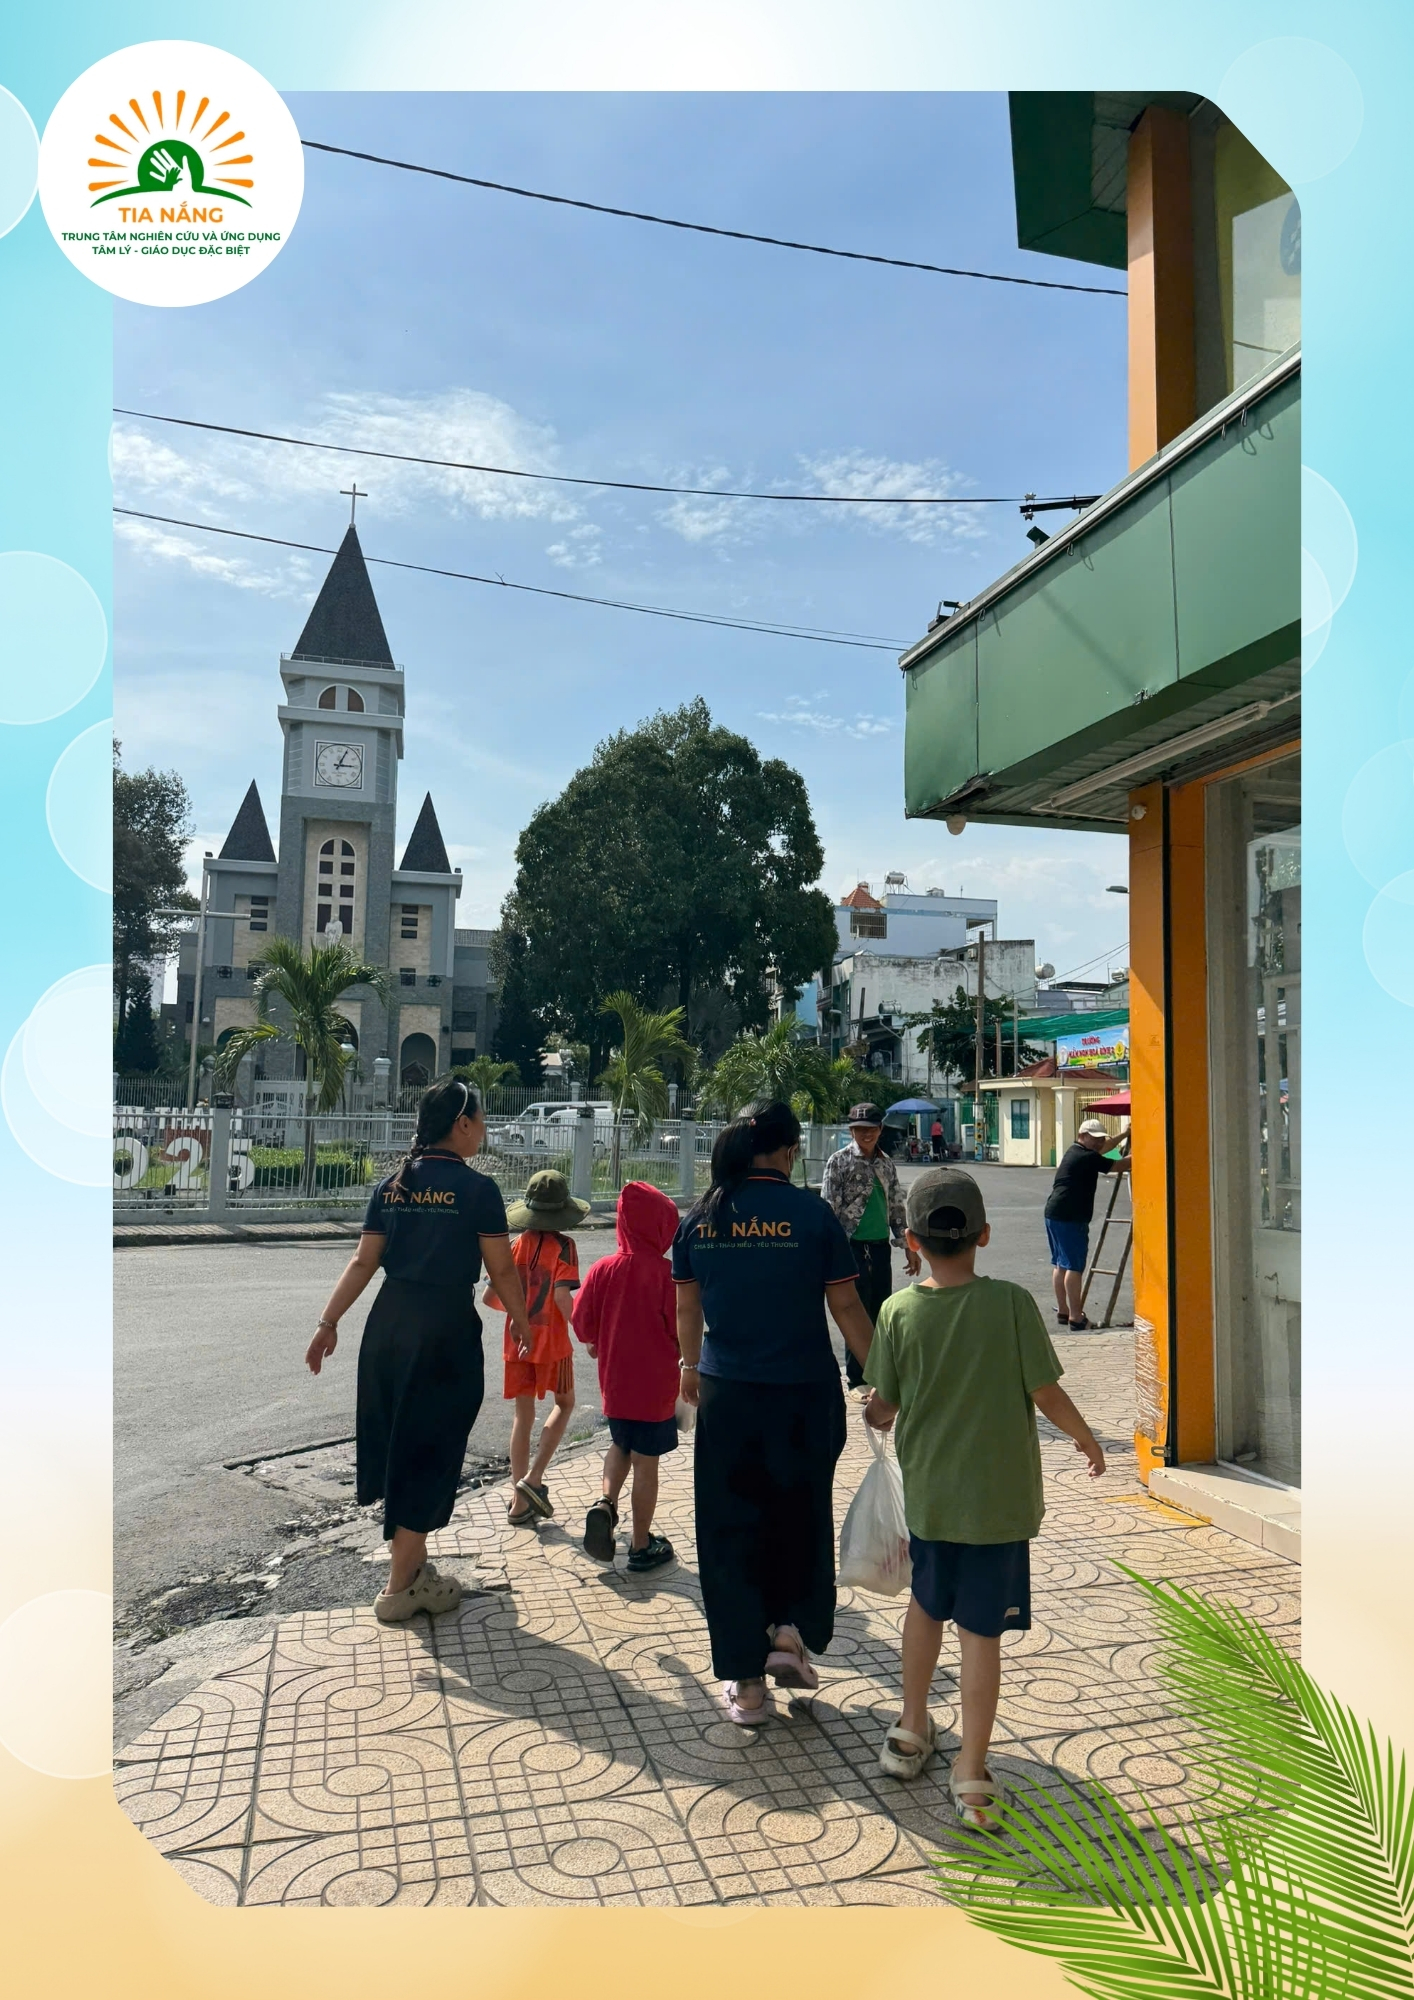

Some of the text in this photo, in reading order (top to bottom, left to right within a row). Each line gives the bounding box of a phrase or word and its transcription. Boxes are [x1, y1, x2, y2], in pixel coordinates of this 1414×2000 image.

[856, 1107, 868, 1119] H
[382, 1186, 456, 1205] TIA NẮNG
[732, 1215, 791, 1237] NẮNG
